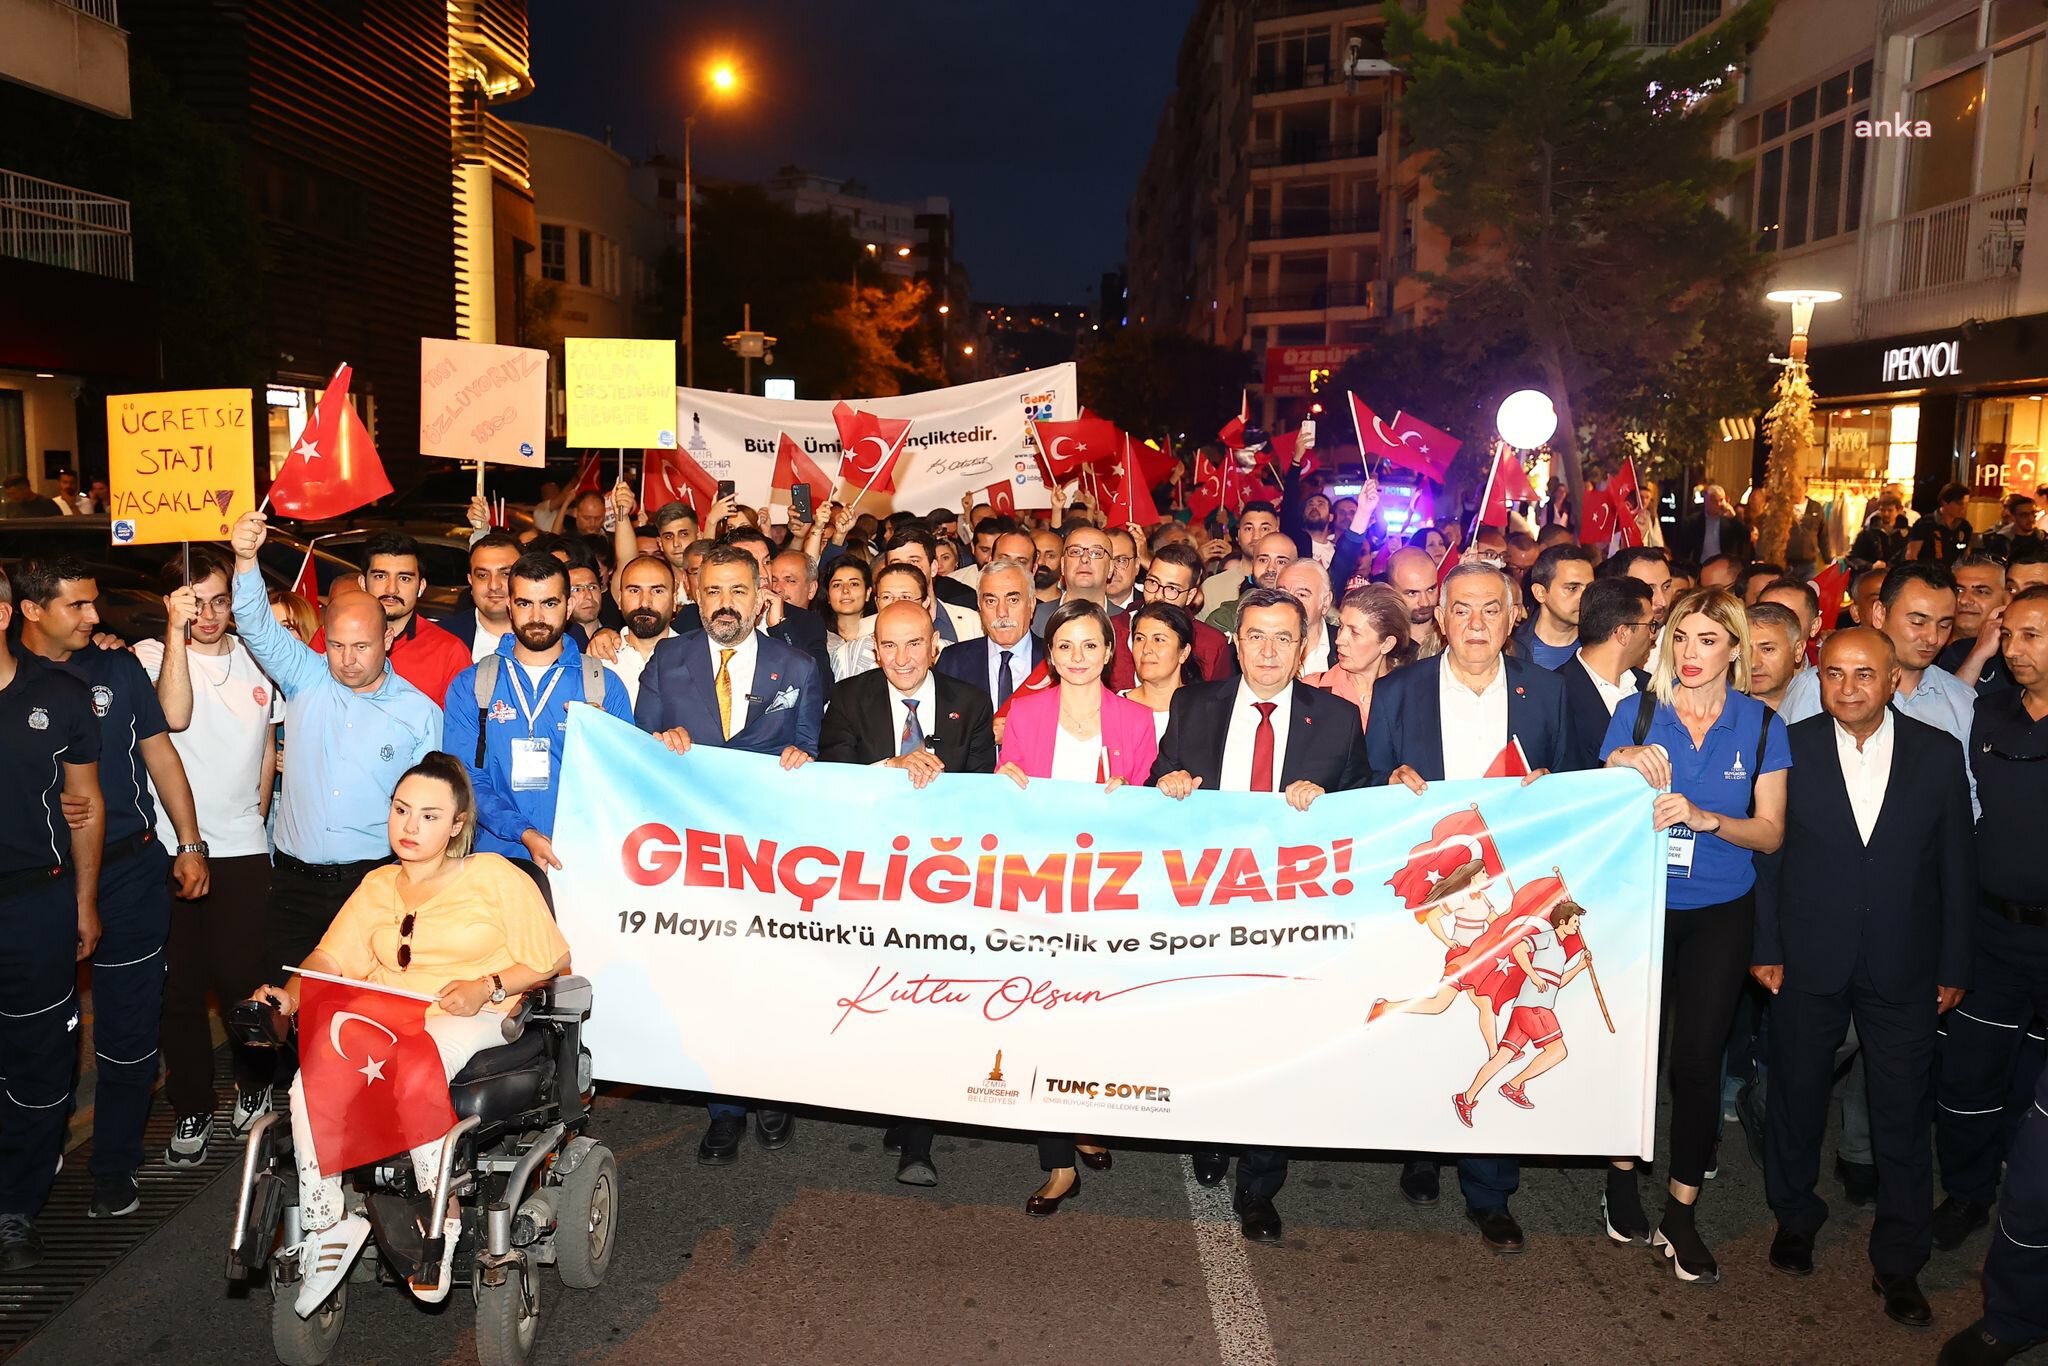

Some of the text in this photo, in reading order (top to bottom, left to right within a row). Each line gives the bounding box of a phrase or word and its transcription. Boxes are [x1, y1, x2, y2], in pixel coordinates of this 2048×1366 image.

[1882, 341, 1961, 382] IPEKYOL
[136, 445, 213, 475] STAJI
[621, 822, 1354, 914] GENÇLİĞİMİZ VAR!
[617, 911, 1356, 958] 19 Mayıs Atatürk'ü Anma, Gençlik ve Spor Bayramı
[831, 966, 990, 1035] Kutlu
[1046, 1078, 1171, 1103] TUNÇ SOYER
